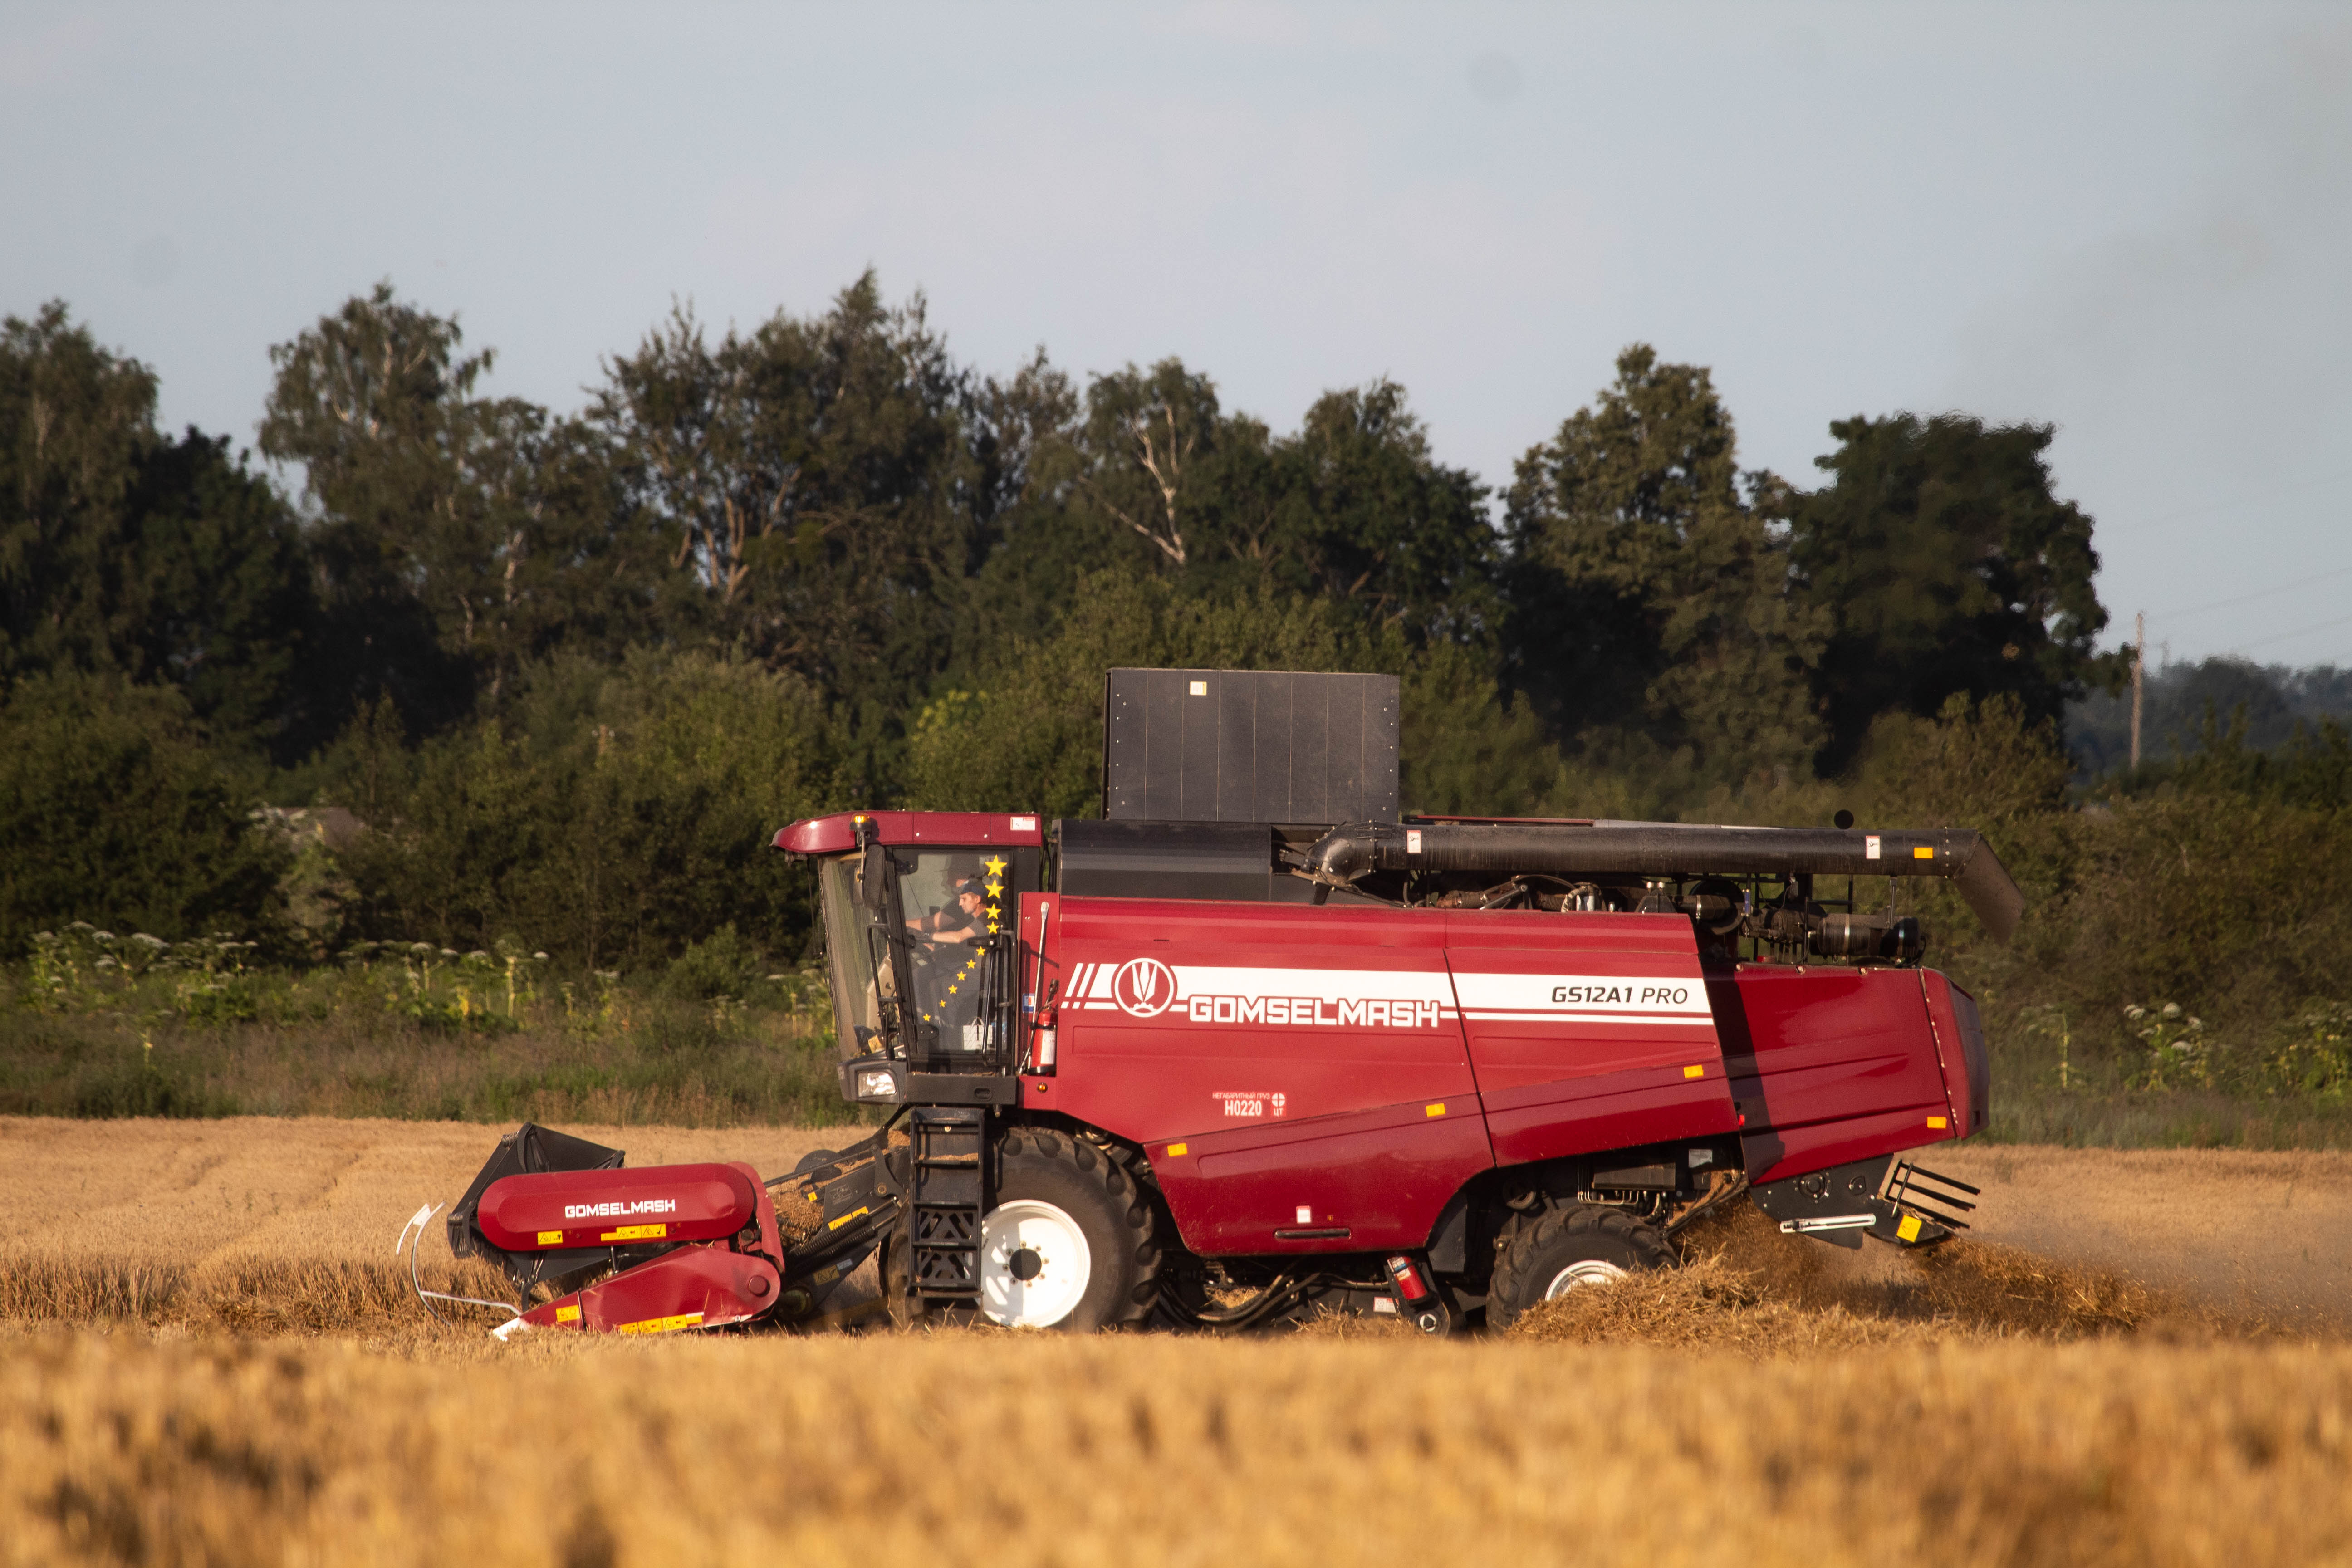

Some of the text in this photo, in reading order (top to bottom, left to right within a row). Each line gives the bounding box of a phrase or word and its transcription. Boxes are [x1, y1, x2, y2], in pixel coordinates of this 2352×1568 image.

[1552, 986, 1688, 1004] GS12A1 PRO
[1189, 996, 1439, 1028] GOMSELMASH
[564, 1199, 676, 1218] GOMSELMASH
